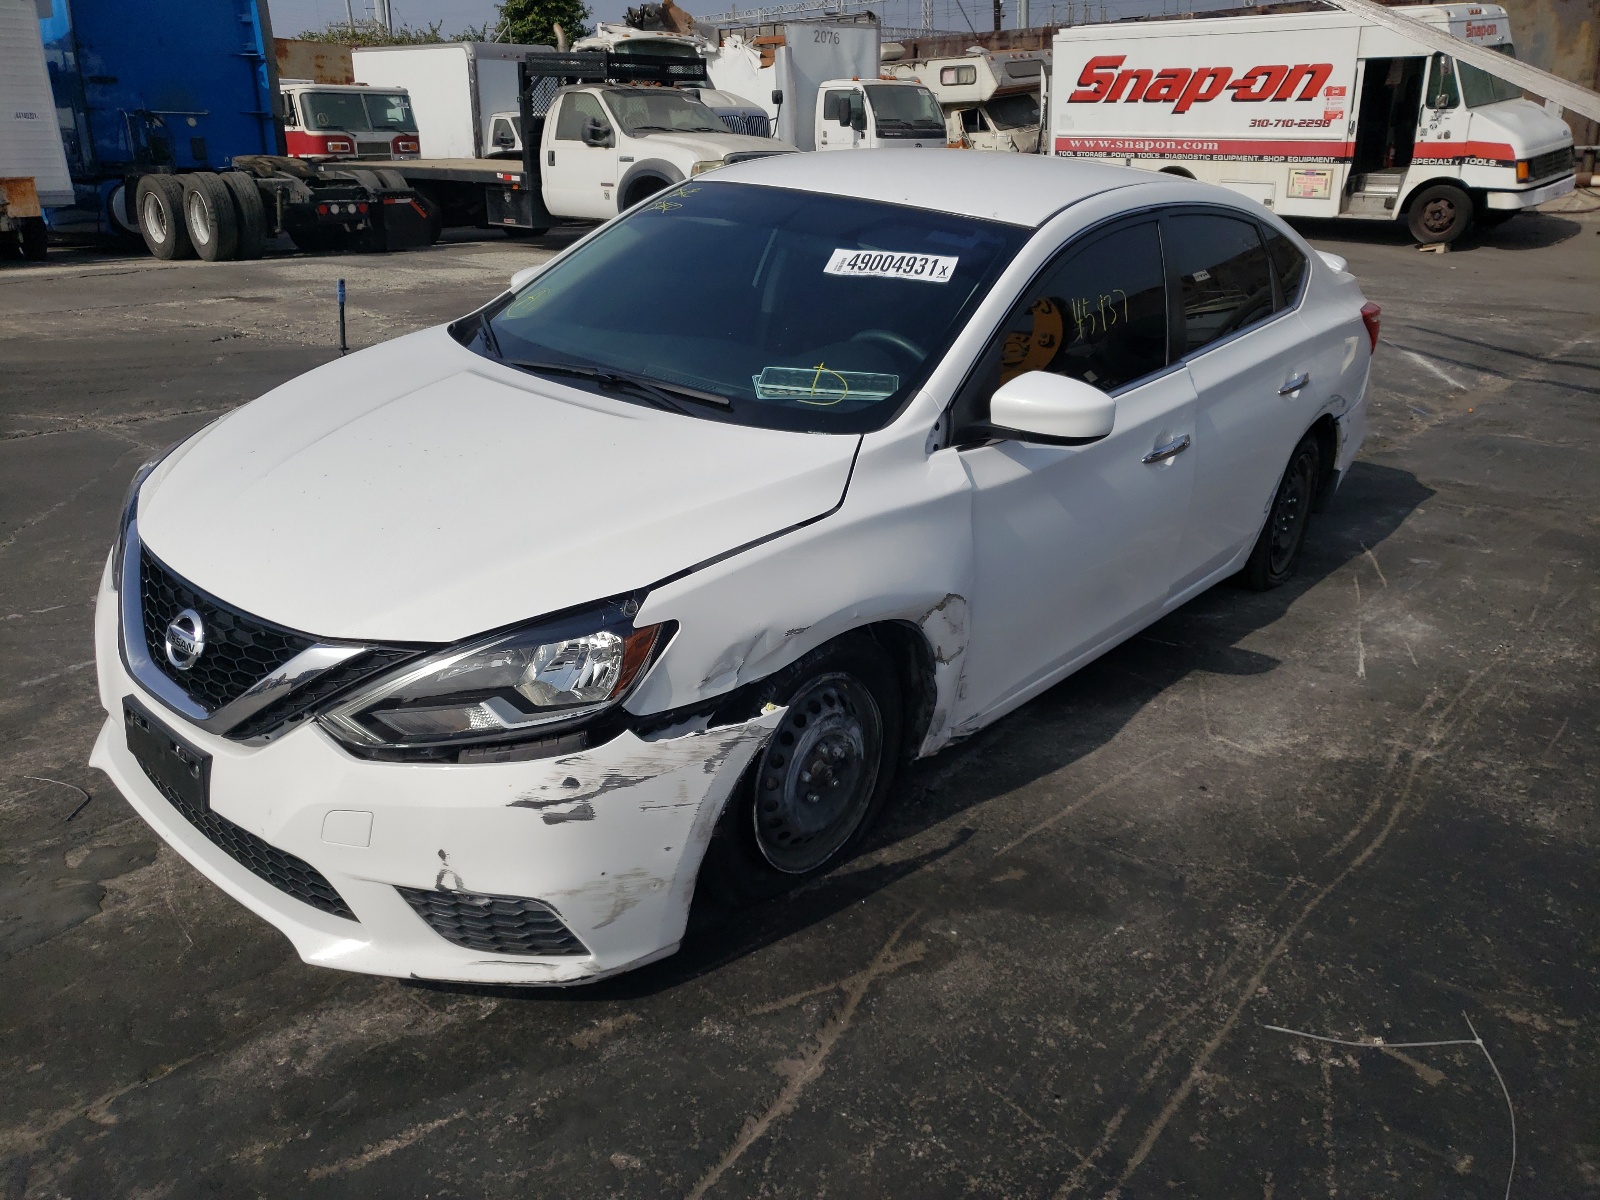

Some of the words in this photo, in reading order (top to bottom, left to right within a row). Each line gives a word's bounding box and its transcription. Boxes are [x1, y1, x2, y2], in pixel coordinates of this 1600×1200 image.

[813, 30, 840, 45] 2076
[1067, 55, 1334, 115] Snap-on
[1069, 139, 1219, 151] www.snapon.com
[1411, 158, 1460, 166] SPECIALTY
[847, 253, 940, 277] 49004931
